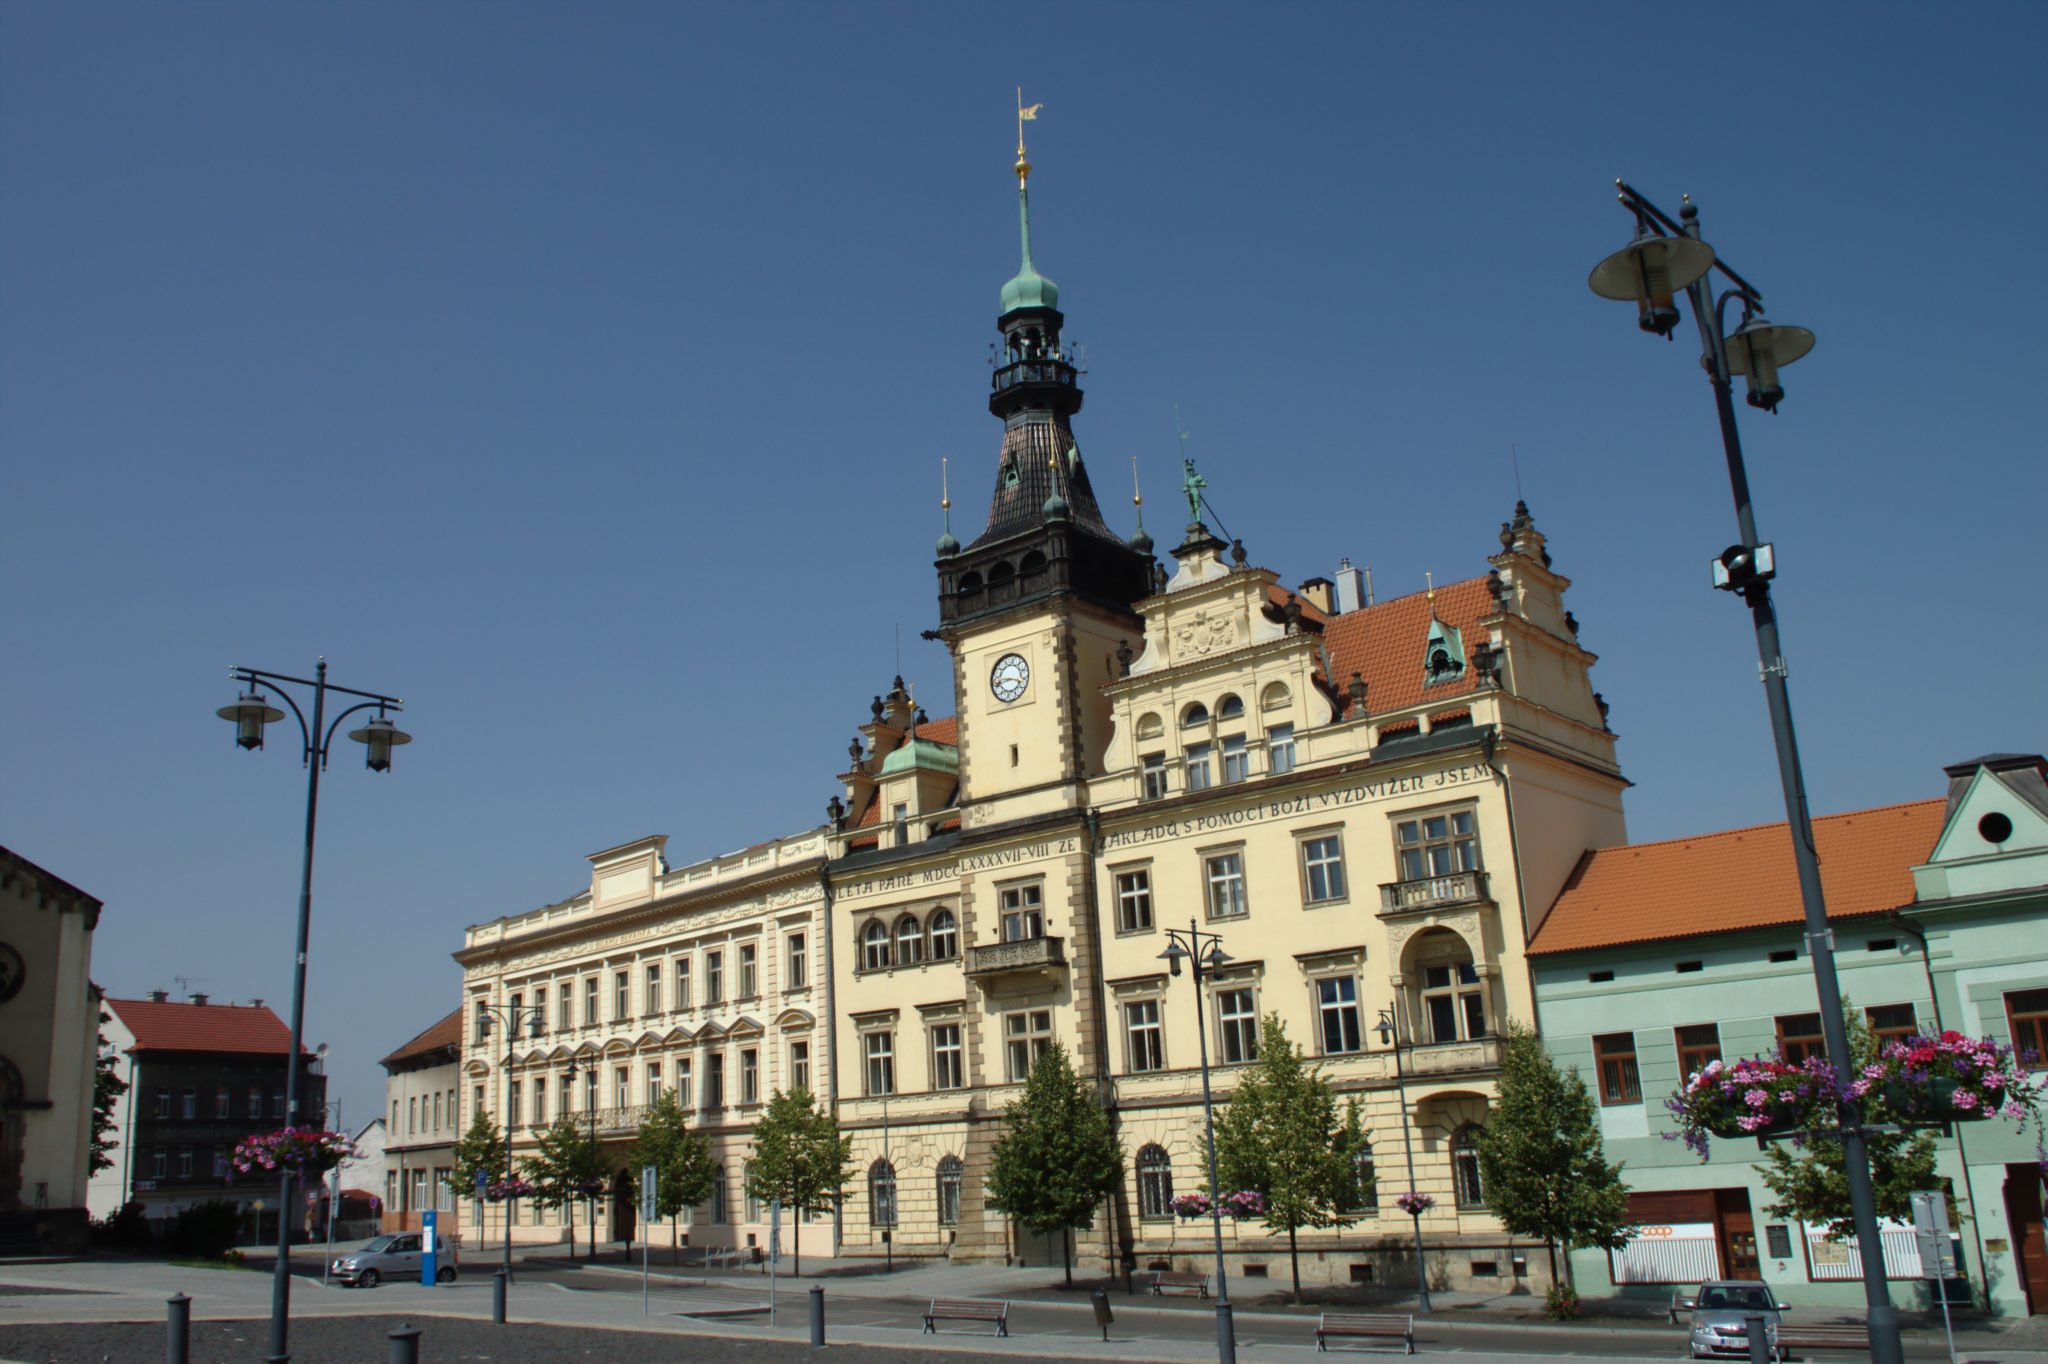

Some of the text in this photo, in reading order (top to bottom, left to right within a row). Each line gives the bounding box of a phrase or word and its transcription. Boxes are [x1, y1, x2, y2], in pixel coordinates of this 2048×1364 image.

[1058, 839, 1076, 854] ZE
[1184, 820, 1192, 833] S
[1197, 803, 1263, 831] POMOCÍ
[1271, 794, 1311, 817] BOŽÍ
[1318, 775, 1424, 806] VYZDVIŽEN
[1642, 1225, 1672, 1239] coop
